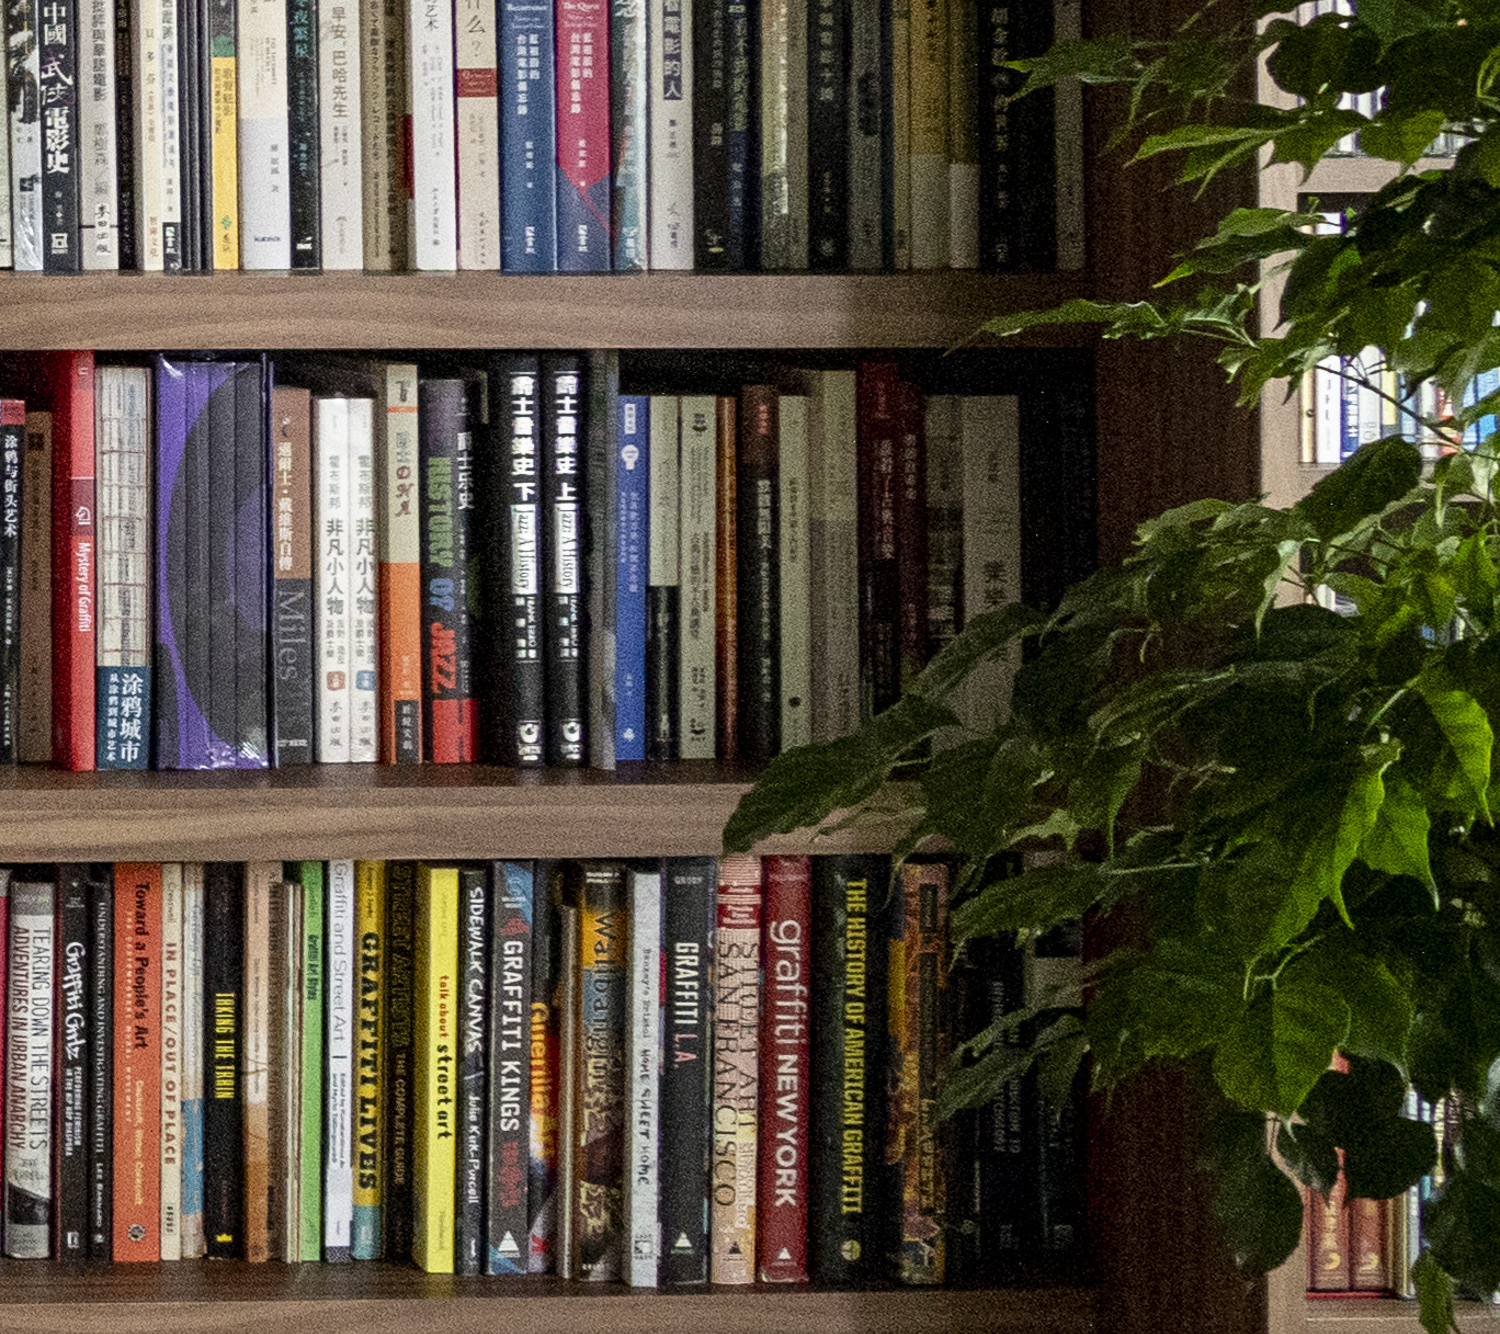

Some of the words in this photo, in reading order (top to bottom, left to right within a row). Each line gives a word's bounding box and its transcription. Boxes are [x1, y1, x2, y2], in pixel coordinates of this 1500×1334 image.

[428, 457, 454, 568] HISTORY
[75, 541, 91, 581] Mystery
[79, 583, 89, 594] of
[326, 518, 344, 616] 非凡小人物
[356, 518, 374, 616] 非凡小人物
[76, 597, 90, 633] Graffiti
[429, 578, 455, 612] OF
[278, 590, 305, 682] Miles
[431, 622, 458, 694] JAZZ
[121, 672, 143, 764] 涂鸦城市
[135, 882, 150, 936] Toward
[332, 862, 350, 924] Graffiti
[846, 878, 867, 913] THE
[12, 927, 29, 1013] ADVENTURES
[38, 927, 51, 990] TEARING
[334, 928, 348, 955] and
[845, 916, 866, 997] HISTORY
[135, 956, 149, 1020] People's
[215, 992, 235, 1034] TAKING
[332, 959, 348, 1013] Street
[360, 932, 380, 1088] GRAFFITI
[439, 974, 449, 997] talk
[500, 940, 523, 1053] GRAFFITI
[673, 941, 700, 1026] GRAFFITI
[770, 918, 808, 1047] graffiti
[34, 996, 50, 1031] DOWN
[134, 1027, 148, 1050] Art
[332, 1017, 345, 1041] Art
[438, 1001, 448, 1038] about
[844, 1002, 866, 1025] OF
[10, 1036, 25, 1082] URBAN
[33, 1041, 49, 1069] THE
[215, 1038, 235, 1061] THE
[437, 1044, 453, 1098] street
[673, 1030, 698, 1069] L.A.
[843, 1029, 866, 1126] AMERICAN
[30, 1075, 48, 1151] STREETS
[215, 1065, 235, 1100] TRAIN
[499, 1061, 522, 1133] KINGS
[775, 1053, 801, 1114] NEW
[9, 1087, 25, 1150] ANARCHY
[357, 1097, 378, 1191] LIVES
[438, 1104, 452, 1140] art
[774, 1115, 800, 1208] YORK
[841, 1131, 864, 1215] GRAFFITI
